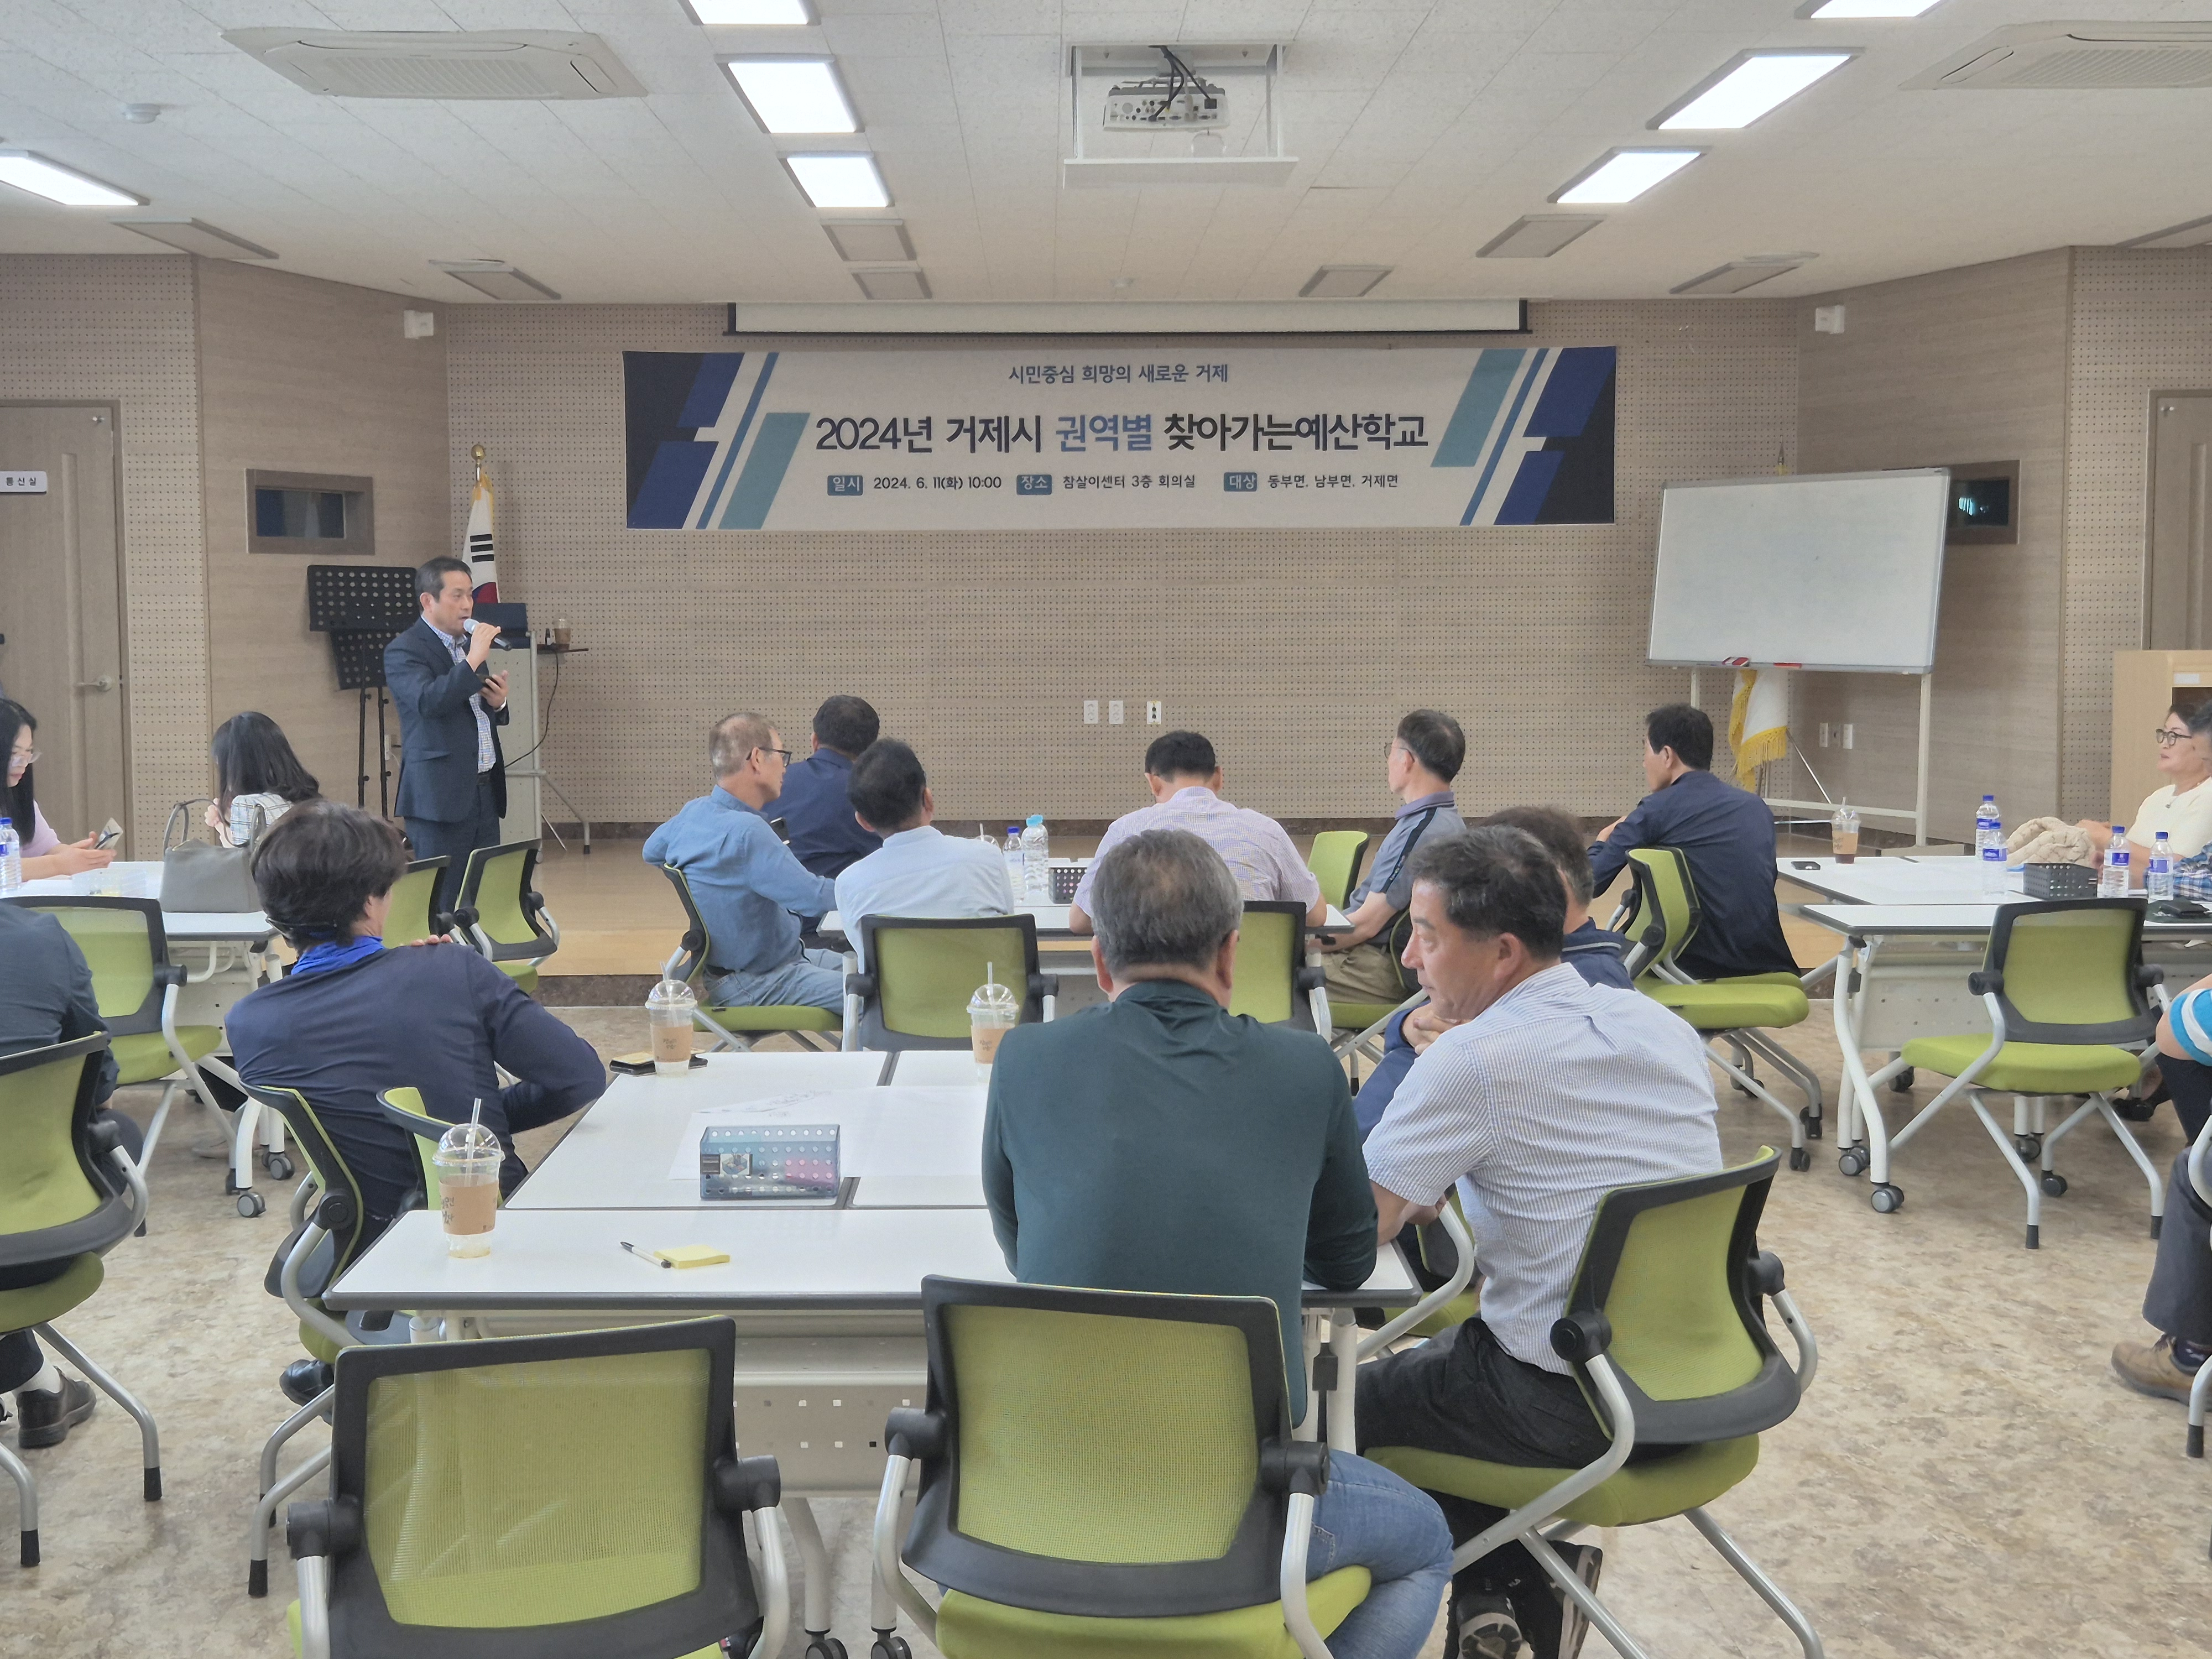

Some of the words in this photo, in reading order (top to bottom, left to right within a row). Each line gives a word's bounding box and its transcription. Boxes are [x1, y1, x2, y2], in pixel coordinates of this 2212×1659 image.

[1008, 365, 1074, 384] 시민중심
[1082, 364, 1131, 384] 희망의
[1138, 363, 1190, 383] 새로운
[1196, 363, 1228, 383] 거제
[816, 416, 933, 453] 2024년
[946, 414, 1042, 454] 거제시
[1055, 414, 1152, 452] 권역별
[1164, 413, 1428, 451] 찾아가는예산학교
[832, 476, 860, 492] 일시
[873, 477, 911, 489] 2024.
[916, 477, 928, 489] 6.
[932, 476, 963, 491] 11(화)
[968, 476, 1002, 489] 10:00
[1021, 476, 1048, 491] 장소
[1063, 475, 1125, 489] 참살이센터
[1131, 474, 1153, 489] 3층
[1158, 474, 1195, 489] 회의실
[1229, 474, 1256, 489] 대상
[1361, 474, 1399, 489] 거제면
